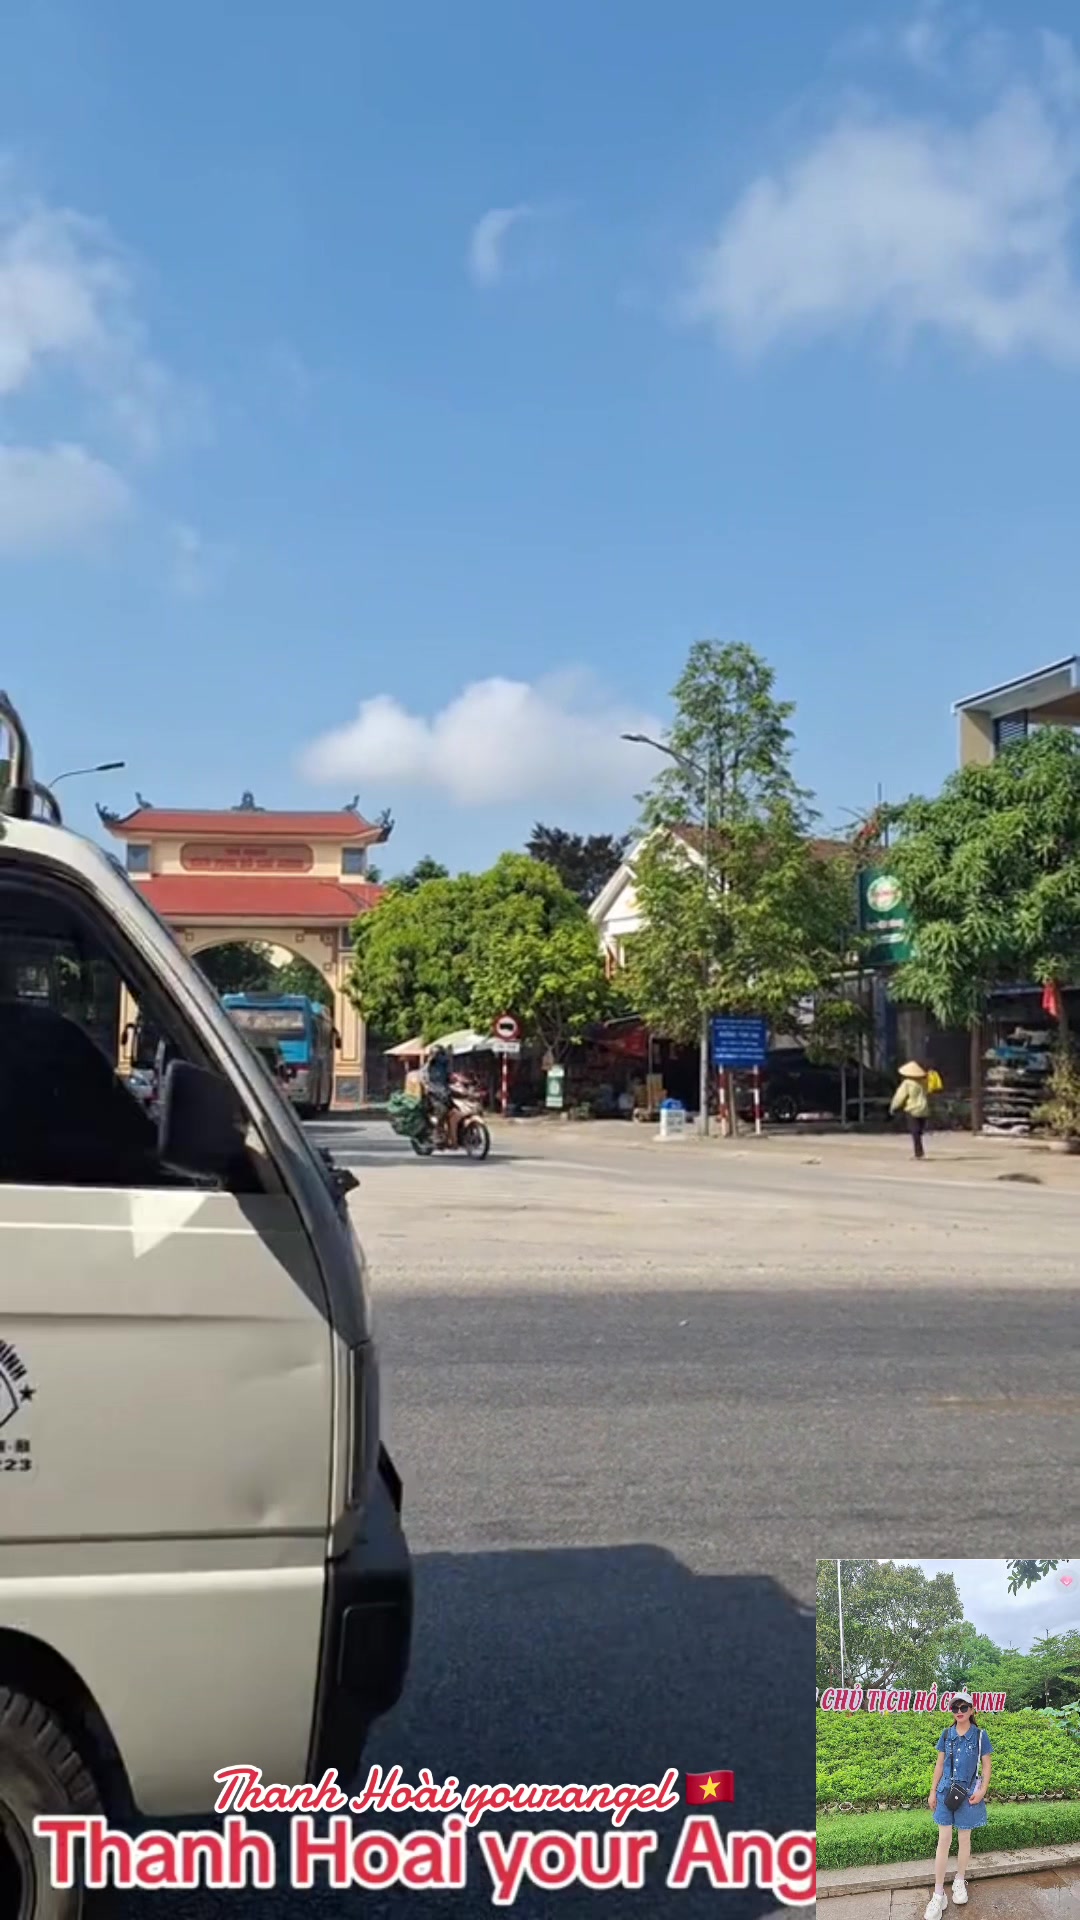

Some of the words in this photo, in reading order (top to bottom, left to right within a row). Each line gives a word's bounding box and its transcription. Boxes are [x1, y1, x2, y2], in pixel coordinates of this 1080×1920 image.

[821, 1683, 862, 1711] CHỦ
[867, 1688, 911, 1714] TỊCH
[913, 1682, 938, 1711] HỒ
